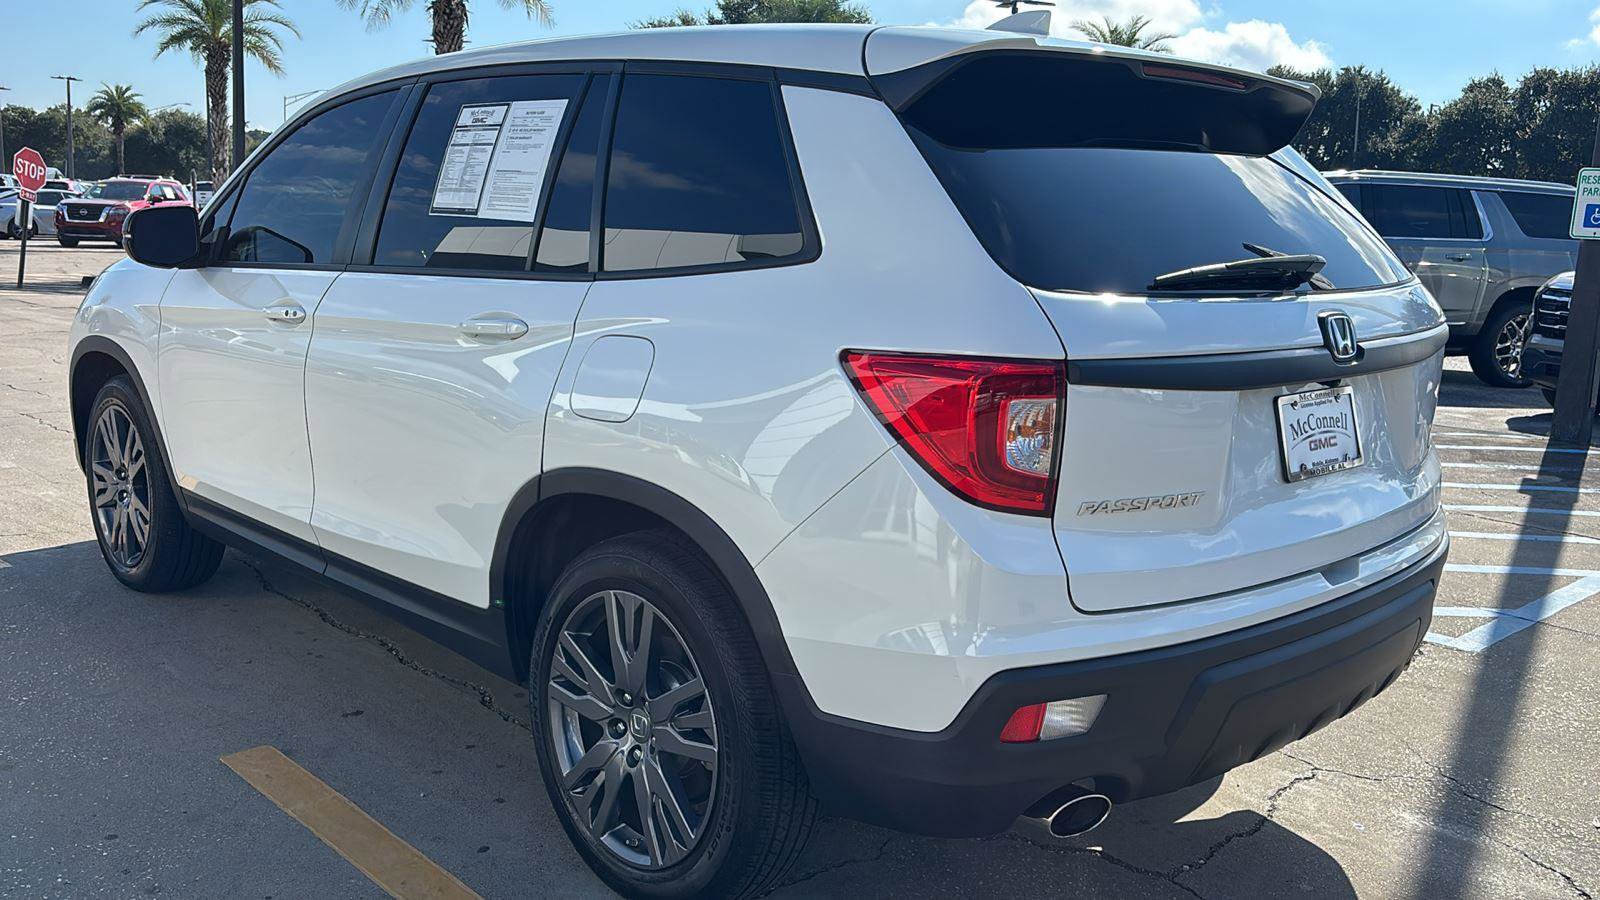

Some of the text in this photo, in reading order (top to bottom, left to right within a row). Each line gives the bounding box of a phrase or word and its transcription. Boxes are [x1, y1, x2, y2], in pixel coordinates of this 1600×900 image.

[16, 158, 45, 180] STOP
[1582, 187, 1600, 197] PAR
[1299, 390, 1335, 400] McConnell
[1289, 412, 1348, 440] McConnell
[1309, 435, 1338, 451] GMC
[1337, 462, 1347, 470] AL
[1076, 490, 1206, 516] PASSPORT
